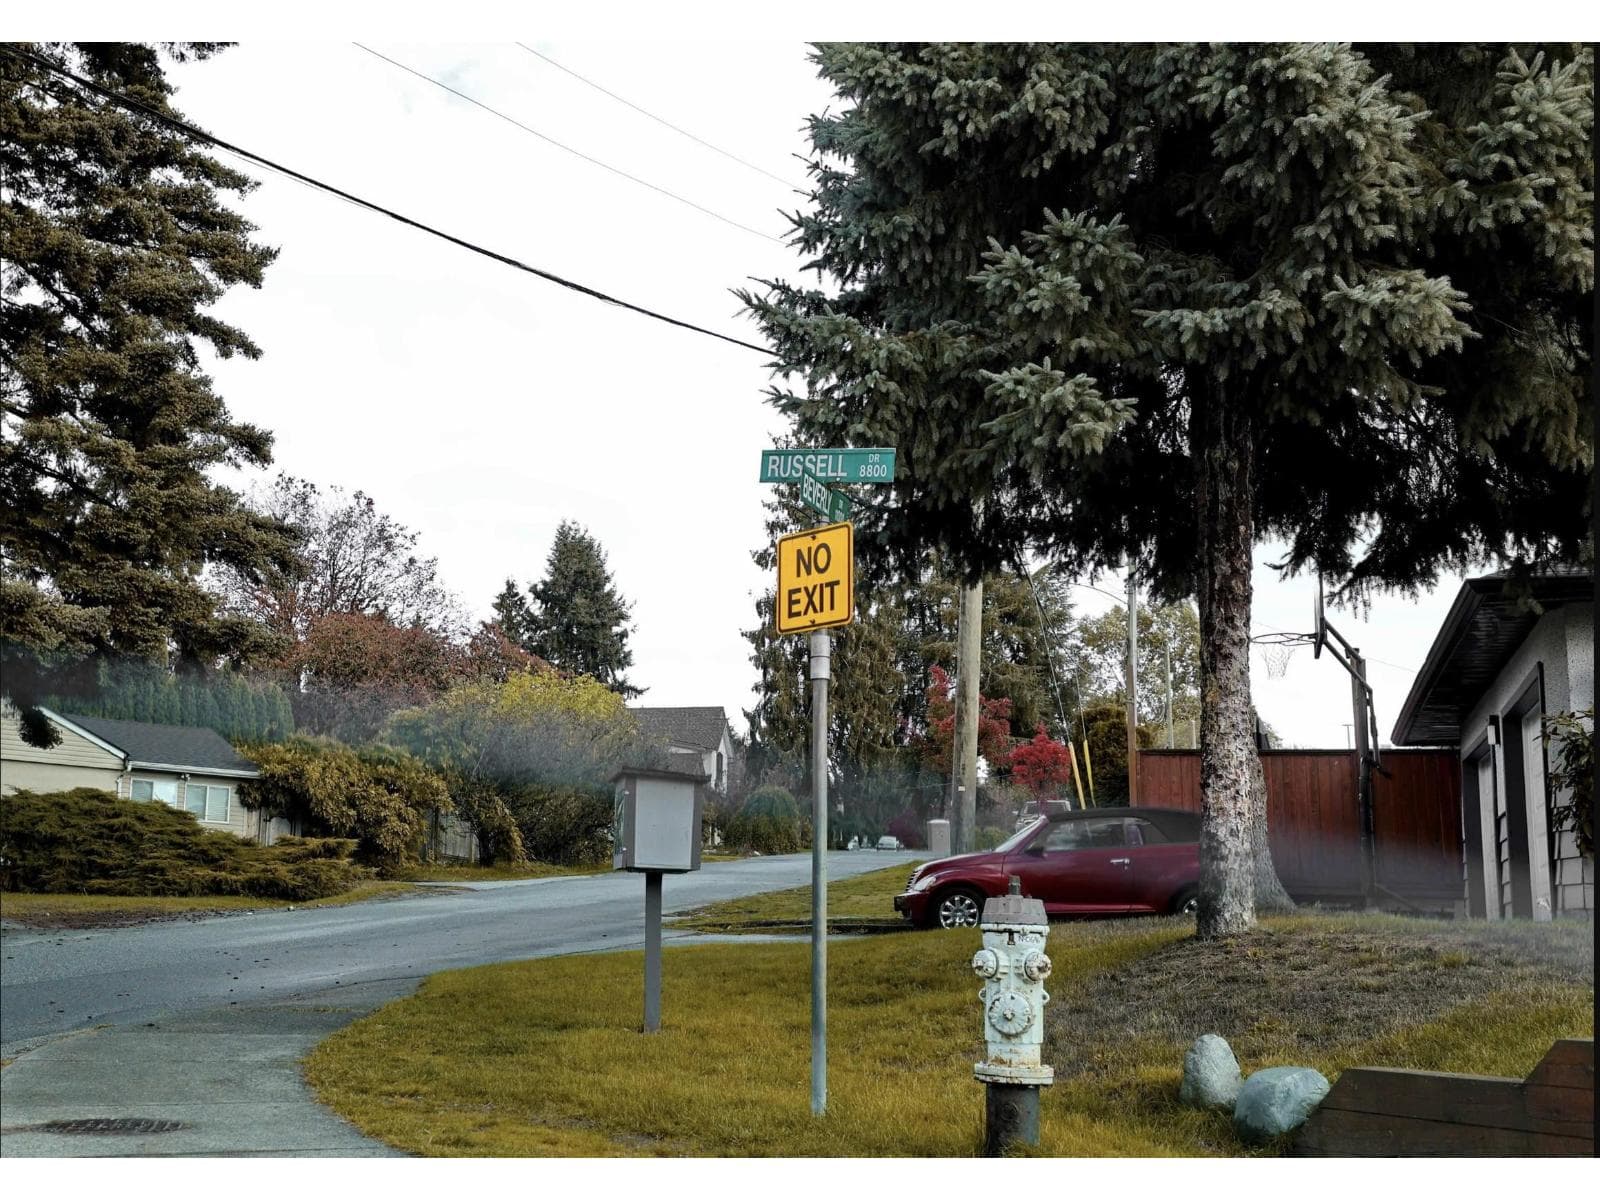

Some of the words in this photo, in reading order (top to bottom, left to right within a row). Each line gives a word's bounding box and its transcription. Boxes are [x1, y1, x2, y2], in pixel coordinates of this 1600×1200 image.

[767, 455, 847, 477] RUSSELL
[859, 464, 887, 477] 8800
[868, 453, 880, 463] DR
[803, 473, 833, 515] BEVERLY
[796, 542, 831, 578] NO
[788, 580, 840, 619] EXIT
